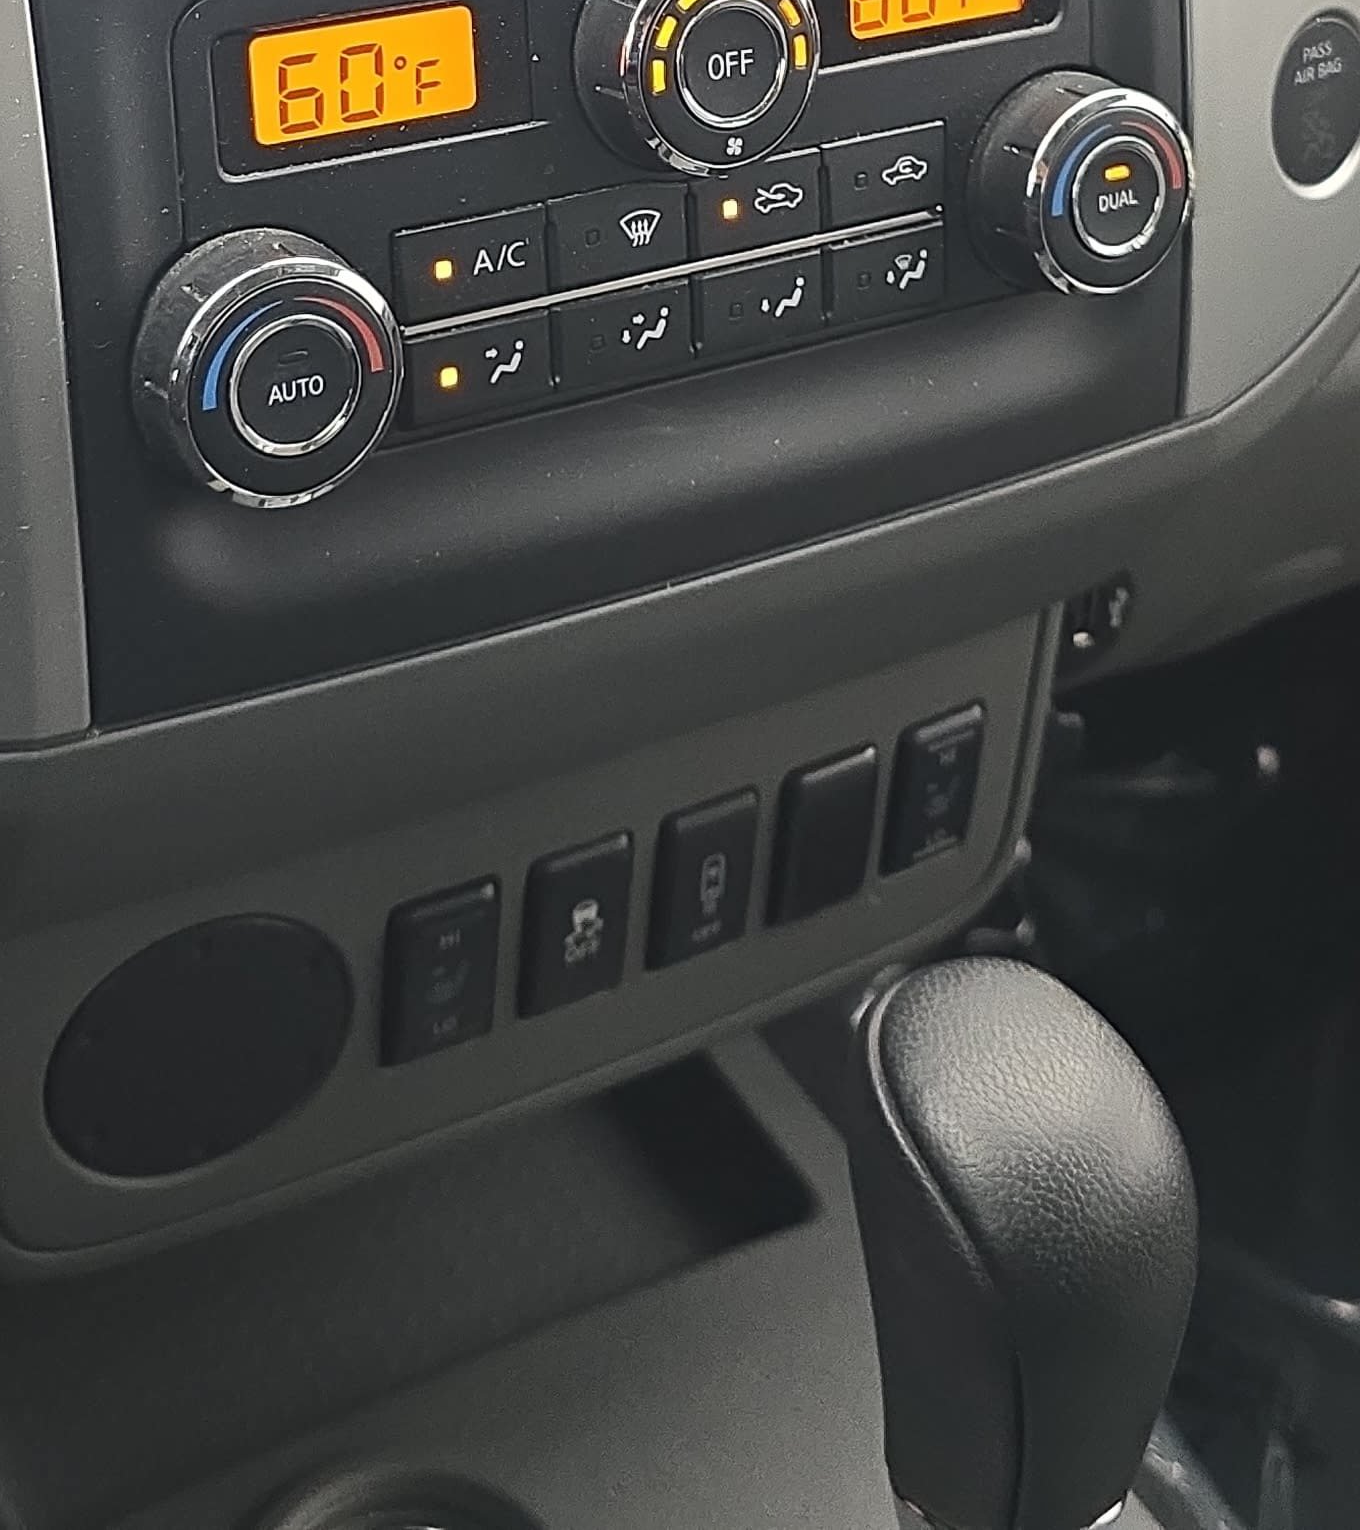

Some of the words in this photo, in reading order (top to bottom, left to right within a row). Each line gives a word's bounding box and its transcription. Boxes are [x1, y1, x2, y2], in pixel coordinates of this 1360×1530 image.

[707, 49, 754, 81] OFF
[1303, 40, 1332, 63] PASS
[1294, 66, 1315, 86] AIR
[1317, 57, 1343, 79] BAG
[1097, 188, 1138, 213] DUAL
[472, 240, 526, 276] A/C
[268, 375, 325, 406] AUTO
